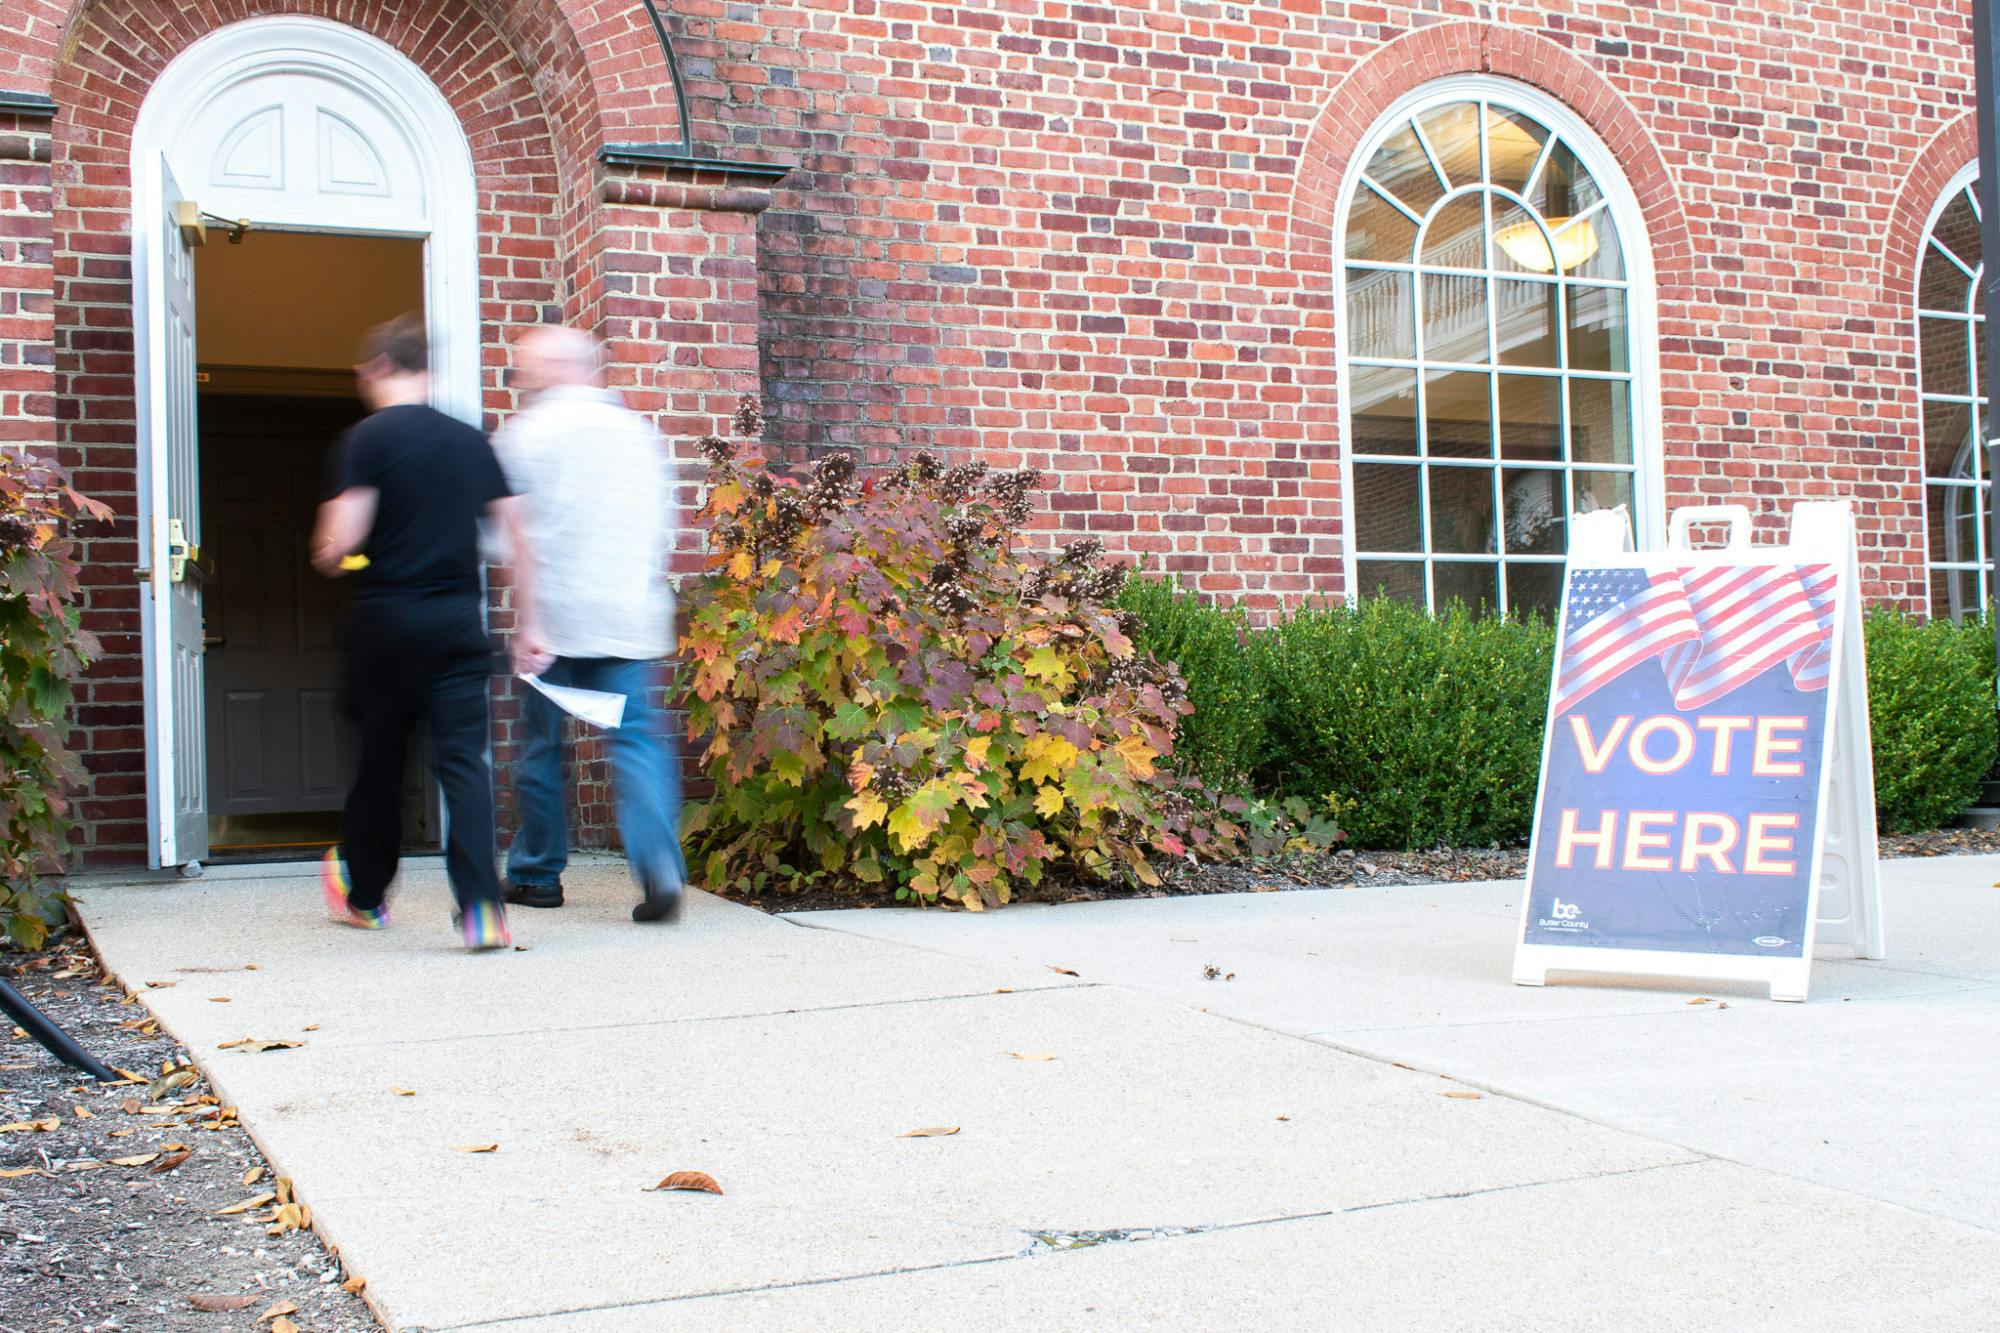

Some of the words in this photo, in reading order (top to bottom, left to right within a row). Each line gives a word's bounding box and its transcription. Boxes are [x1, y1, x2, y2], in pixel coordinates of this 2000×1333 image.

[1569, 715, 1807, 775] VOTE
[1555, 808, 1799, 875] HERE
[1539, 919, 1560, 927] Butler
[1561, 920, 1589, 929] County
